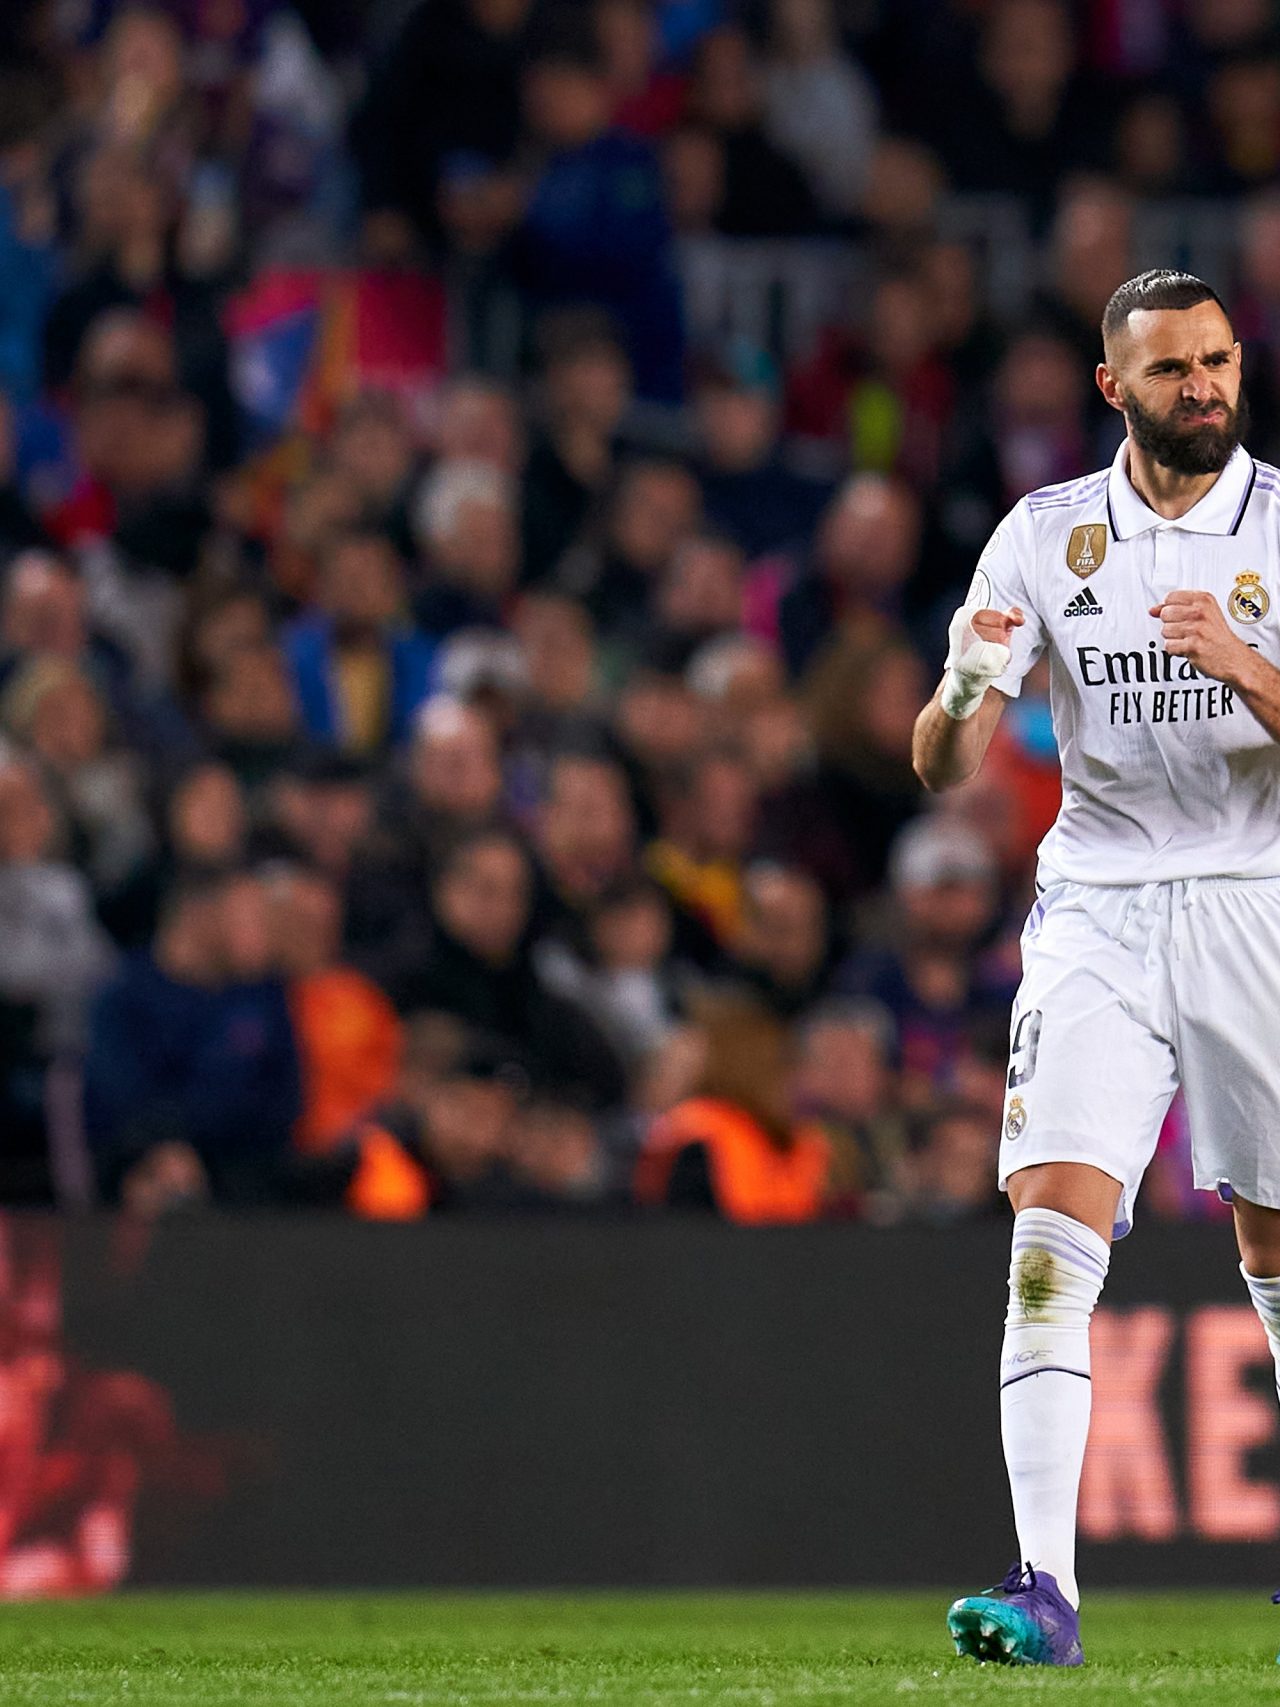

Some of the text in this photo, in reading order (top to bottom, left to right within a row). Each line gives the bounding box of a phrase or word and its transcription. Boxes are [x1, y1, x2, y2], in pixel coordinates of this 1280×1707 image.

[1076, 557, 1096, 567] FIFA
[1063, 604, 1104, 618] adidas
[1076, 640, 1259, 687] Emira
[1110, 684, 1235, 725] FLY BETTER
[1008, 1008, 1043, 1089] 9
